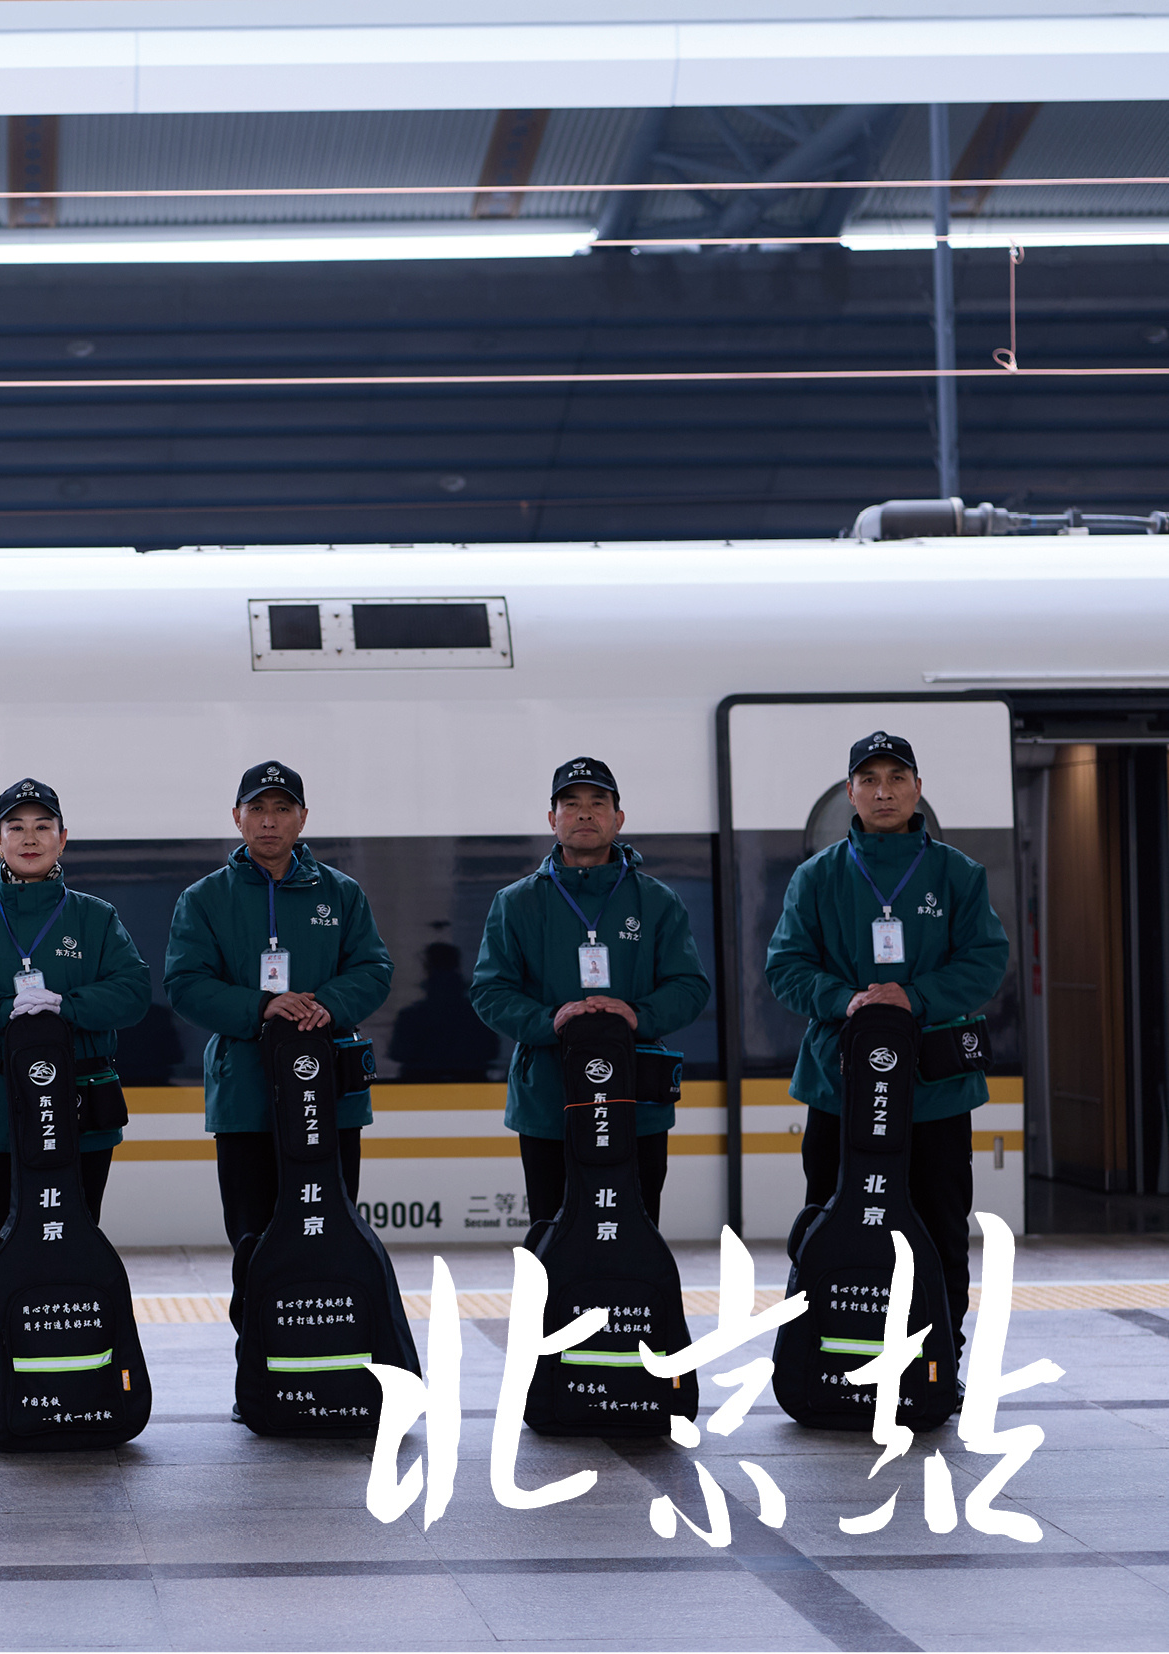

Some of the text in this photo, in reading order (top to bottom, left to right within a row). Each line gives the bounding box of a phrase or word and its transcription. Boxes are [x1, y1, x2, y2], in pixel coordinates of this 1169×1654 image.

[16, 790, 39, 798] 东方之星
[311, 916, 338, 926] 东方之星
[873, 1082, 888, 1135] 东方之星
[40, 1096, 56, 1150] 东方之星
[304, 1091, 319, 1145] 东方之星
[594, 1093, 609, 1146] 东方之星
[862, 1175, 886, 1225] 北京
[40, 1188, 63, 1240] 北京
[301, 1184, 324, 1235] 北京
[595, 1189, 618, 1240] 北京
[465, 1217, 500, 1228] Second
[23, 1301, 100, 1314] 用心守护高铁形象
[277, 1297, 353, 1309] 用心守护高铁形象
[573, 1305, 651, 1317] 用高铁形象
[25, 1318, 102, 1331] 用手打造良好环境
[278, 1313, 355, 1325] 用手打造良好环境
[568, 1381, 607, 1394] 中国高铁
[22, 1396, 61, 1407] 中国高铁
[277, 1391, 315, 1401] 中国高铁
